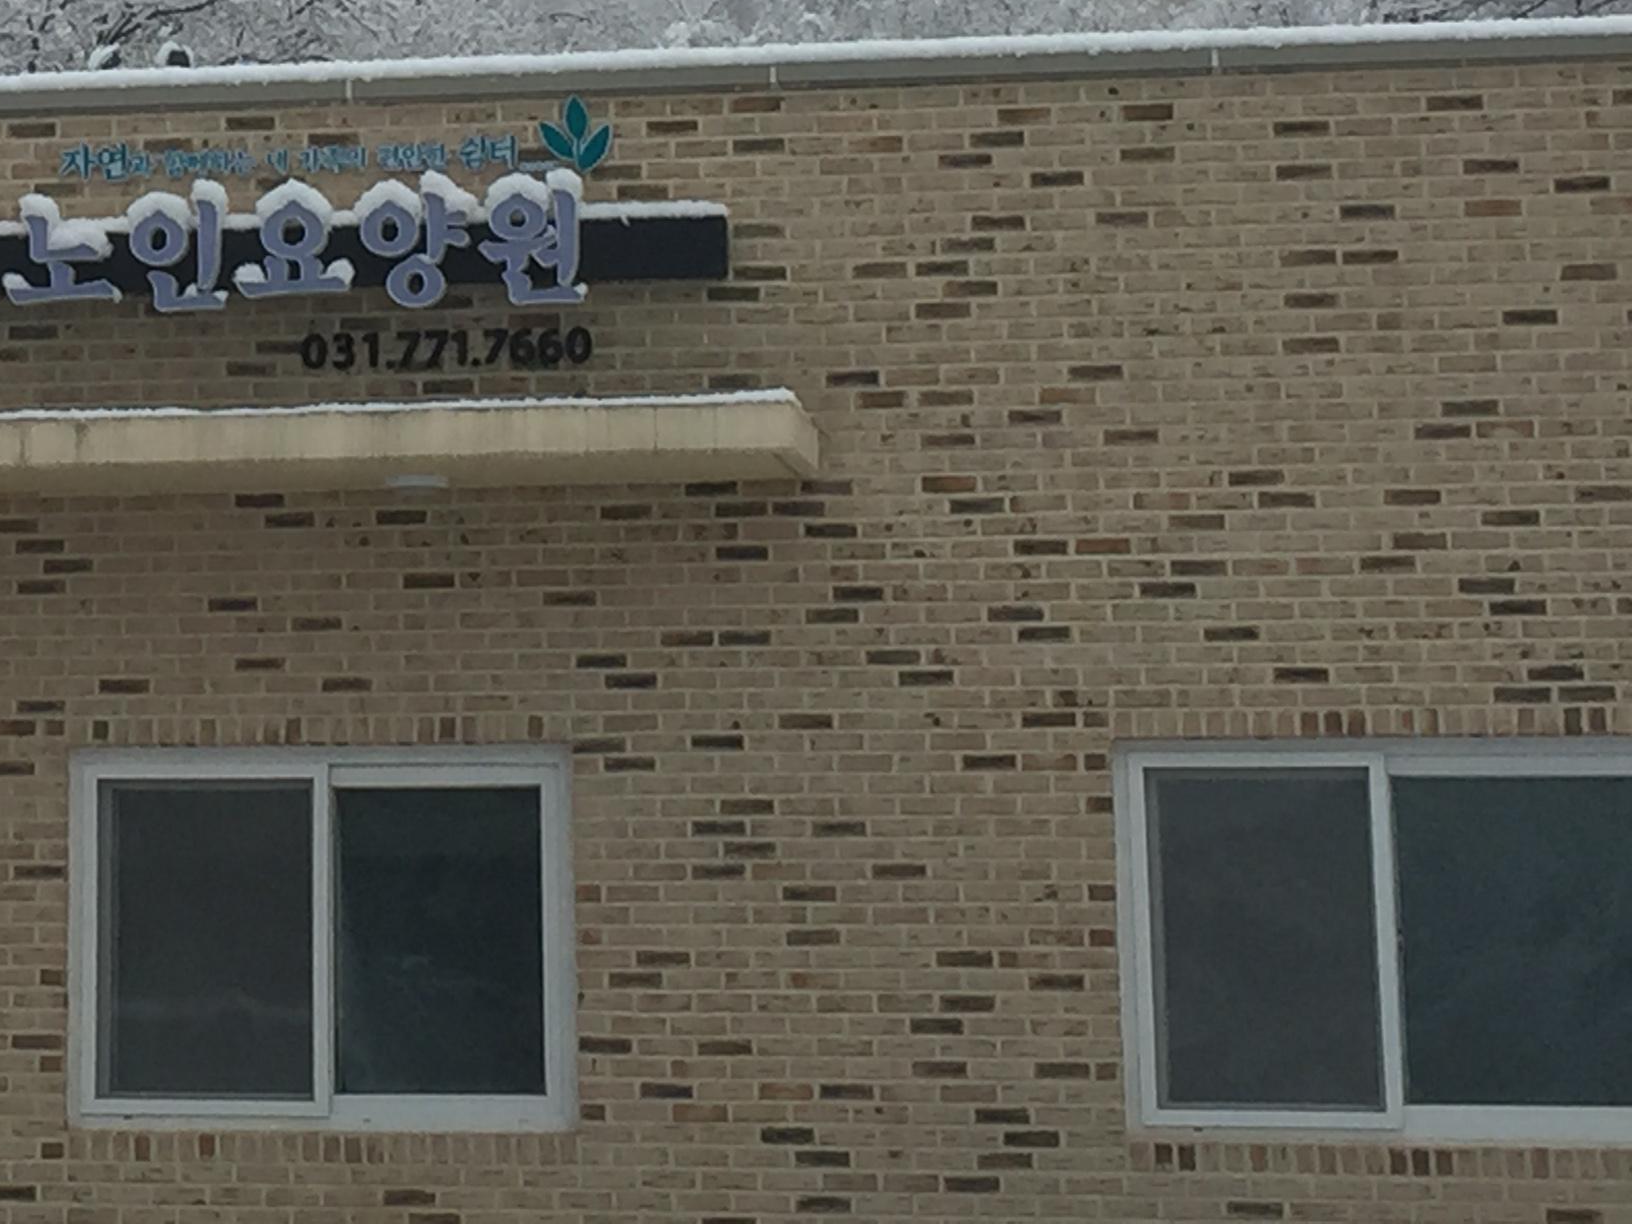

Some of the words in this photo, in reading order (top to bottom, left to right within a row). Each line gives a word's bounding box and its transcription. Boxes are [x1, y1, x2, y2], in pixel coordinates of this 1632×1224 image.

[59, 141, 151, 181] 자연과
[460, 135, 519, 170] 쉼터
[2, 181, 587, 312] 노인요양원
[300, 326, 593, 371] 031.771.7660
